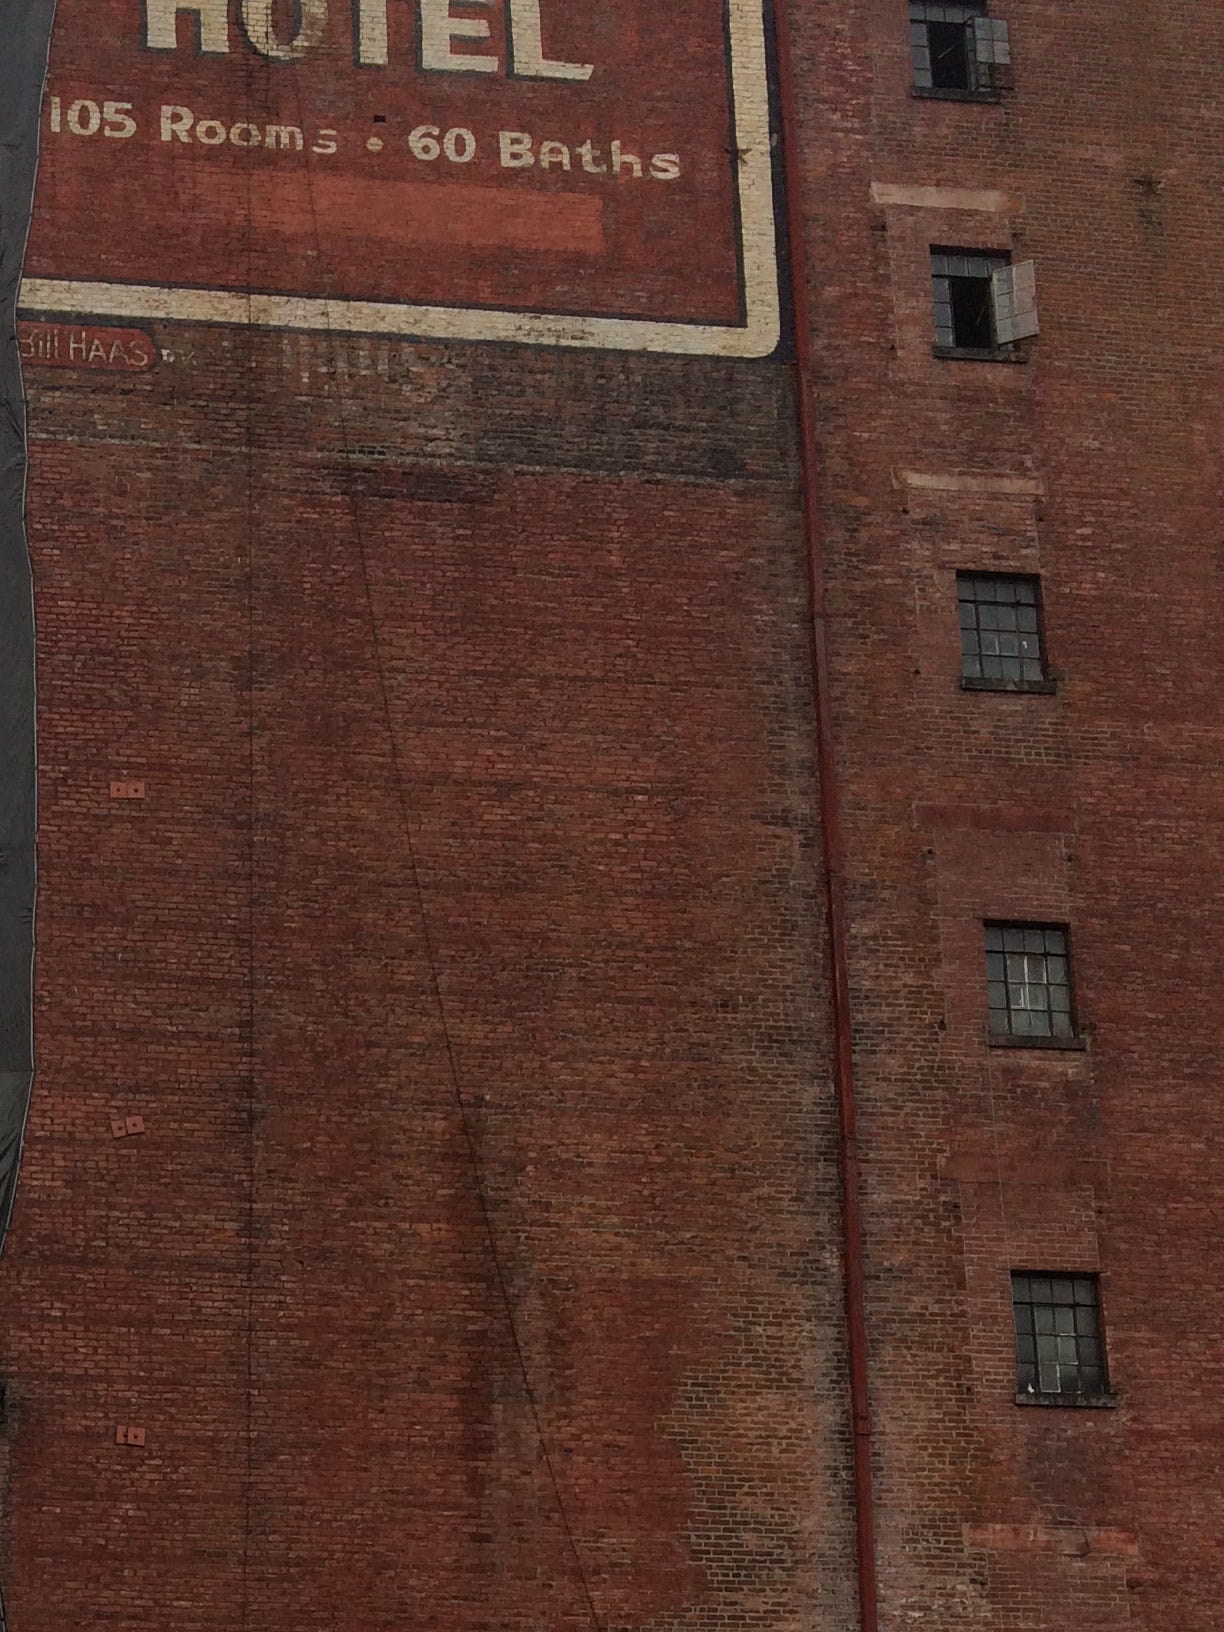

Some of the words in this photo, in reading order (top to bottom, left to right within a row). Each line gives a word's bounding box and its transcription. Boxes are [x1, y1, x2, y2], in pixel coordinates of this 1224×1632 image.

[144, 0, 595, 81] HOTEL
[49, 96, 138, 139] 105
[159, 104, 339, 155] Rooms
[407, 124, 477, 164] 60
[69, 330, 148, 367] HAAS
